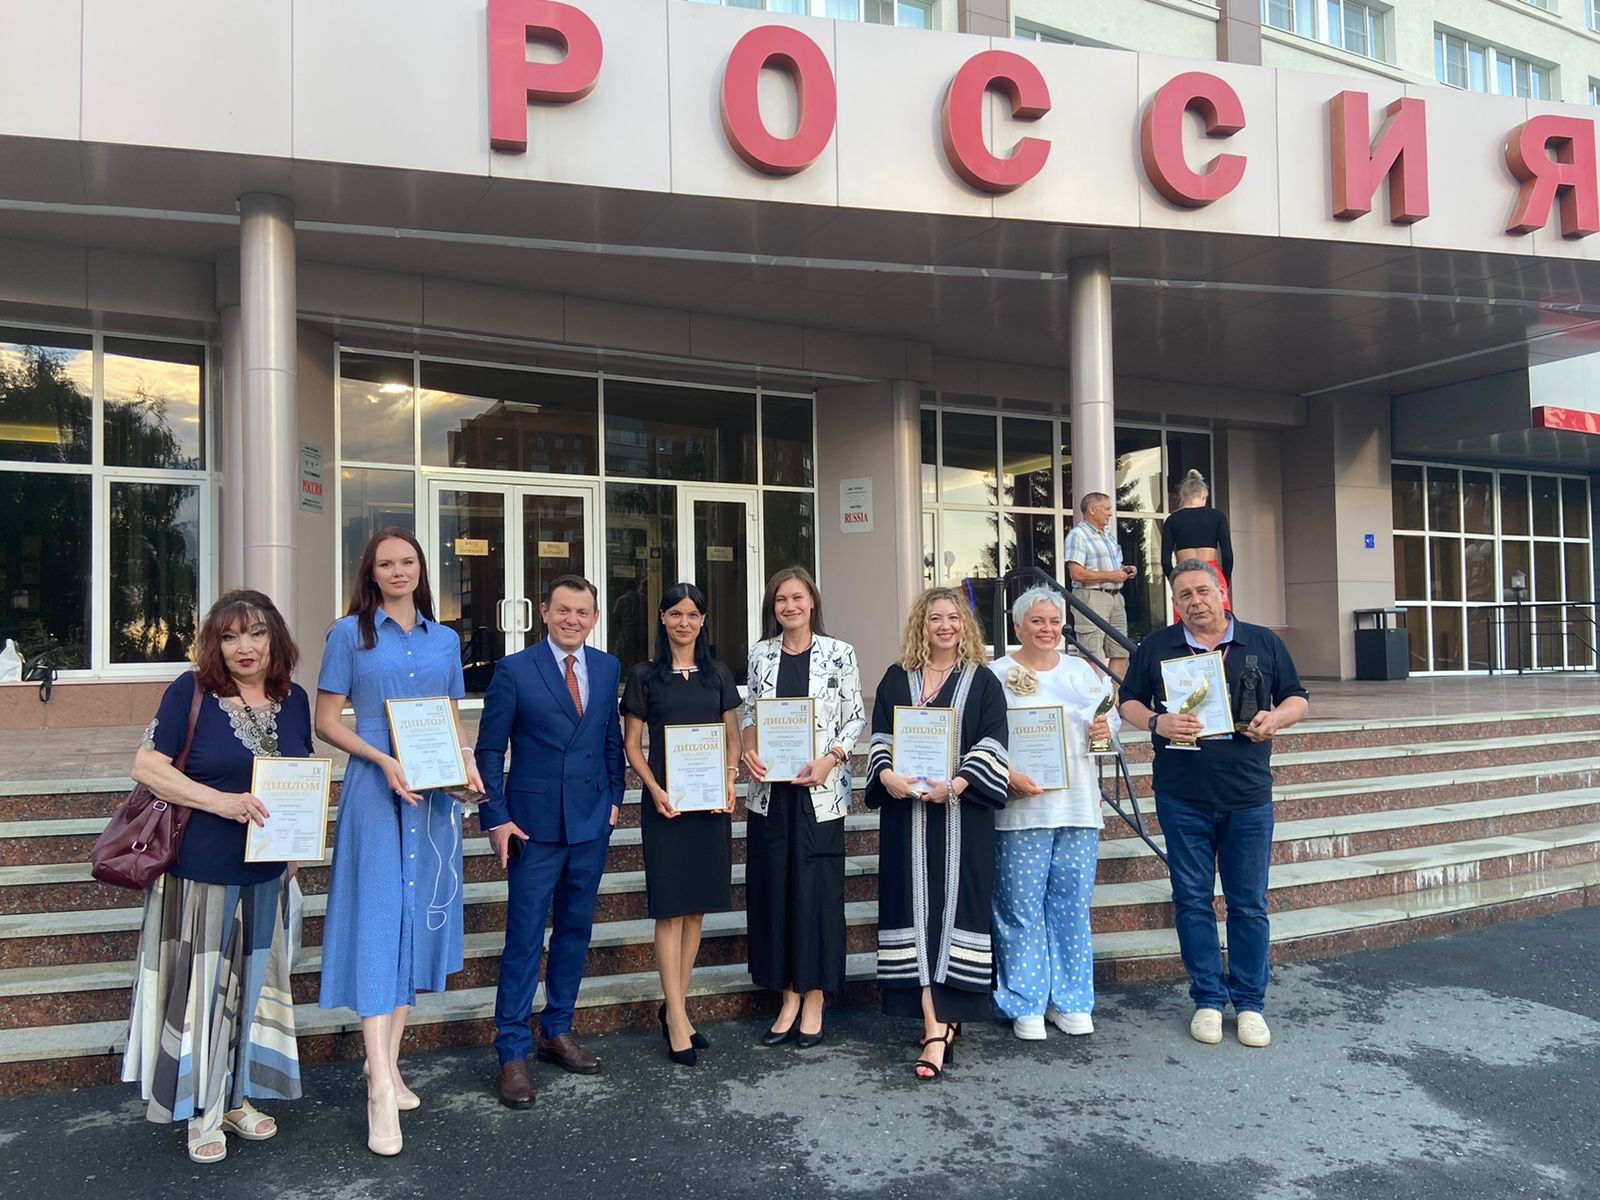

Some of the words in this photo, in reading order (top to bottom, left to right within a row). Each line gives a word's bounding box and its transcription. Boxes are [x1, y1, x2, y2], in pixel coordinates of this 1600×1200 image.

[487, 0, 1600, 240] РОССИЯ
[844, 512, 868, 524] RUSSIA
[763, 716, 807, 725] ДИПЛОМ
[902, 727, 946, 736] ДИПЛОМ
[1013, 725, 1057, 735] ДИПЛОМ
[673, 743, 719, 752] ДИПЛОМ
[262, 782, 320, 792] ДИПЛОМ
